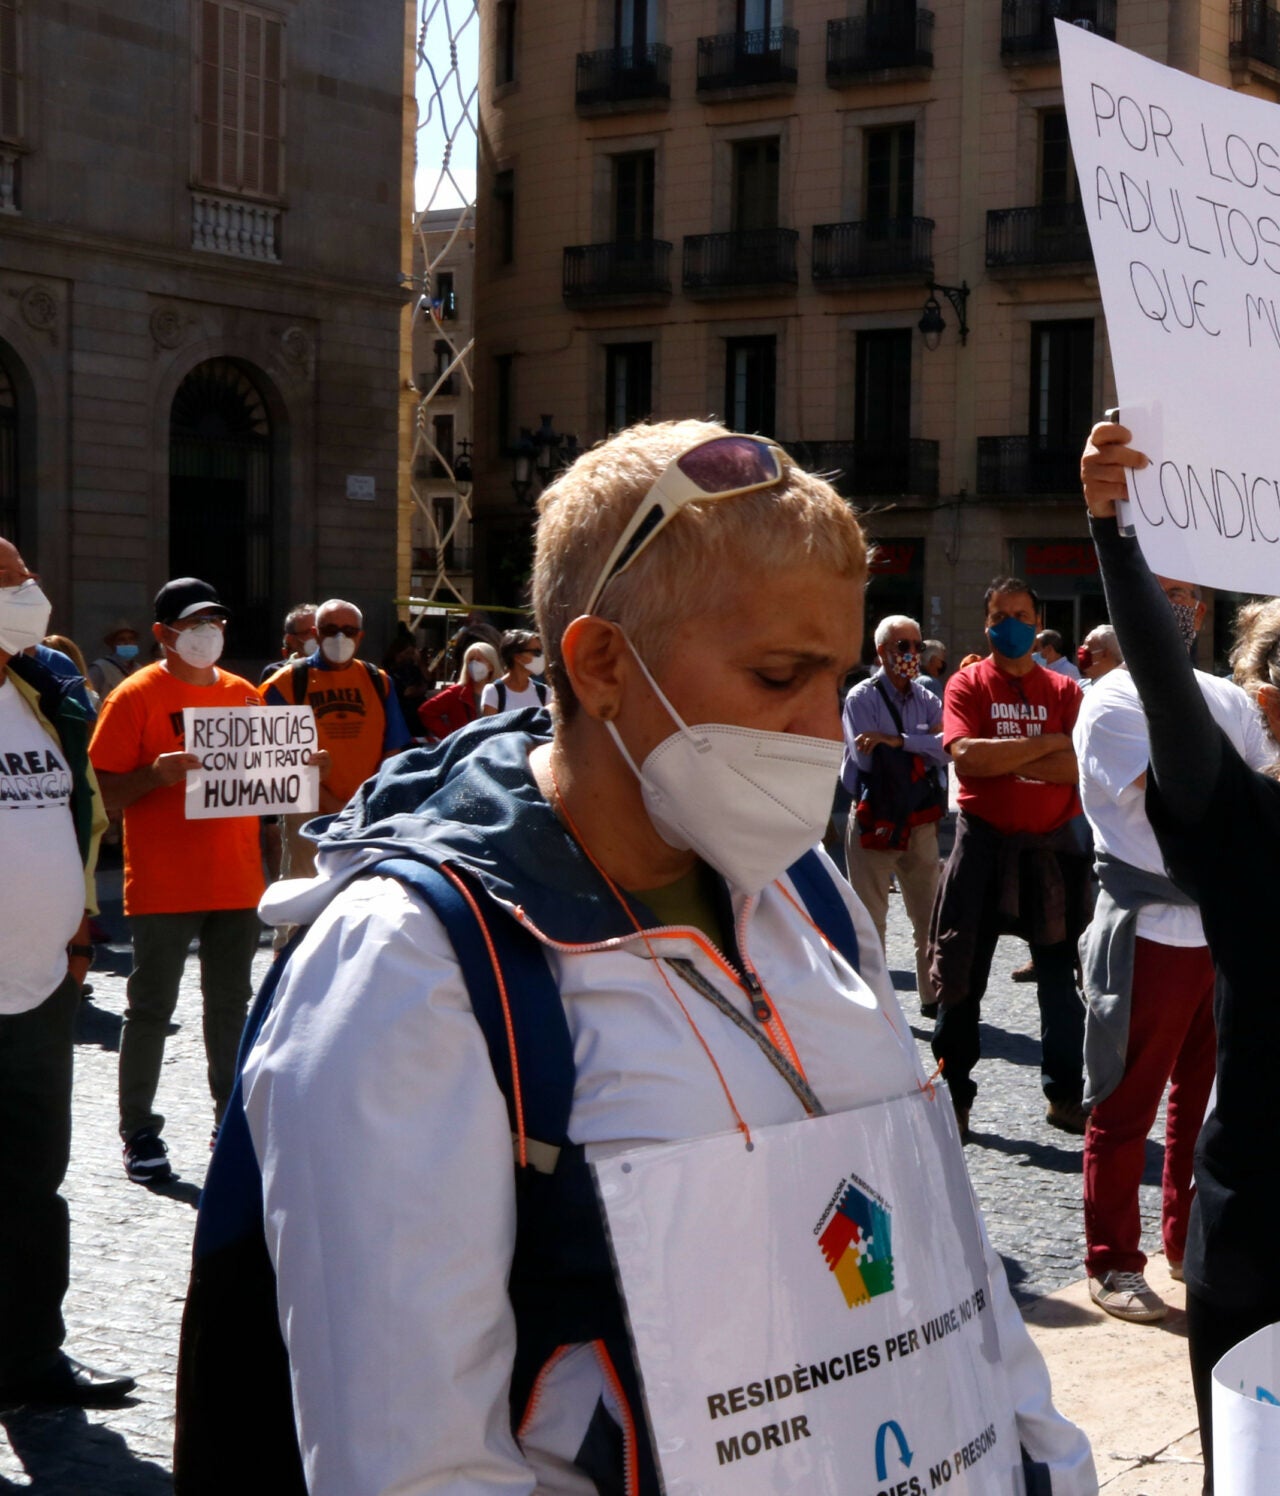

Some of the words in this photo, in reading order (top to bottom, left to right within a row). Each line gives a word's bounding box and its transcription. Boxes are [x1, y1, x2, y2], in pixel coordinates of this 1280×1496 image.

[1091, 83, 1184, 166] POR
[1129, 261, 1221, 337] QUE
[991, 702, 1047, 720] DONALD
[997, 721, 1021, 735] ERES
[1027, 722, 1041, 736] UN
[203, 752, 237, 771] CON
[244, 751, 262, 769] UN
[265, 748, 312, 768] TRATO
[204, 775, 300, 808] HUMANO
[813, 1177, 848, 1236] COORDINADORA
[707, 1344, 881, 1420] RESIDÈNCIES
[885, 1329, 920, 1362] PER
[921, 1308, 960, 1345] VIURE,
[959, 1299, 972, 1326] NO
[971, 1288, 986, 1316] PER
[715, 1414, 811, 1466] MORIR
[929, 1460, 952, 1490] NO
[953, 1424, 997, 1475] PRESONS
